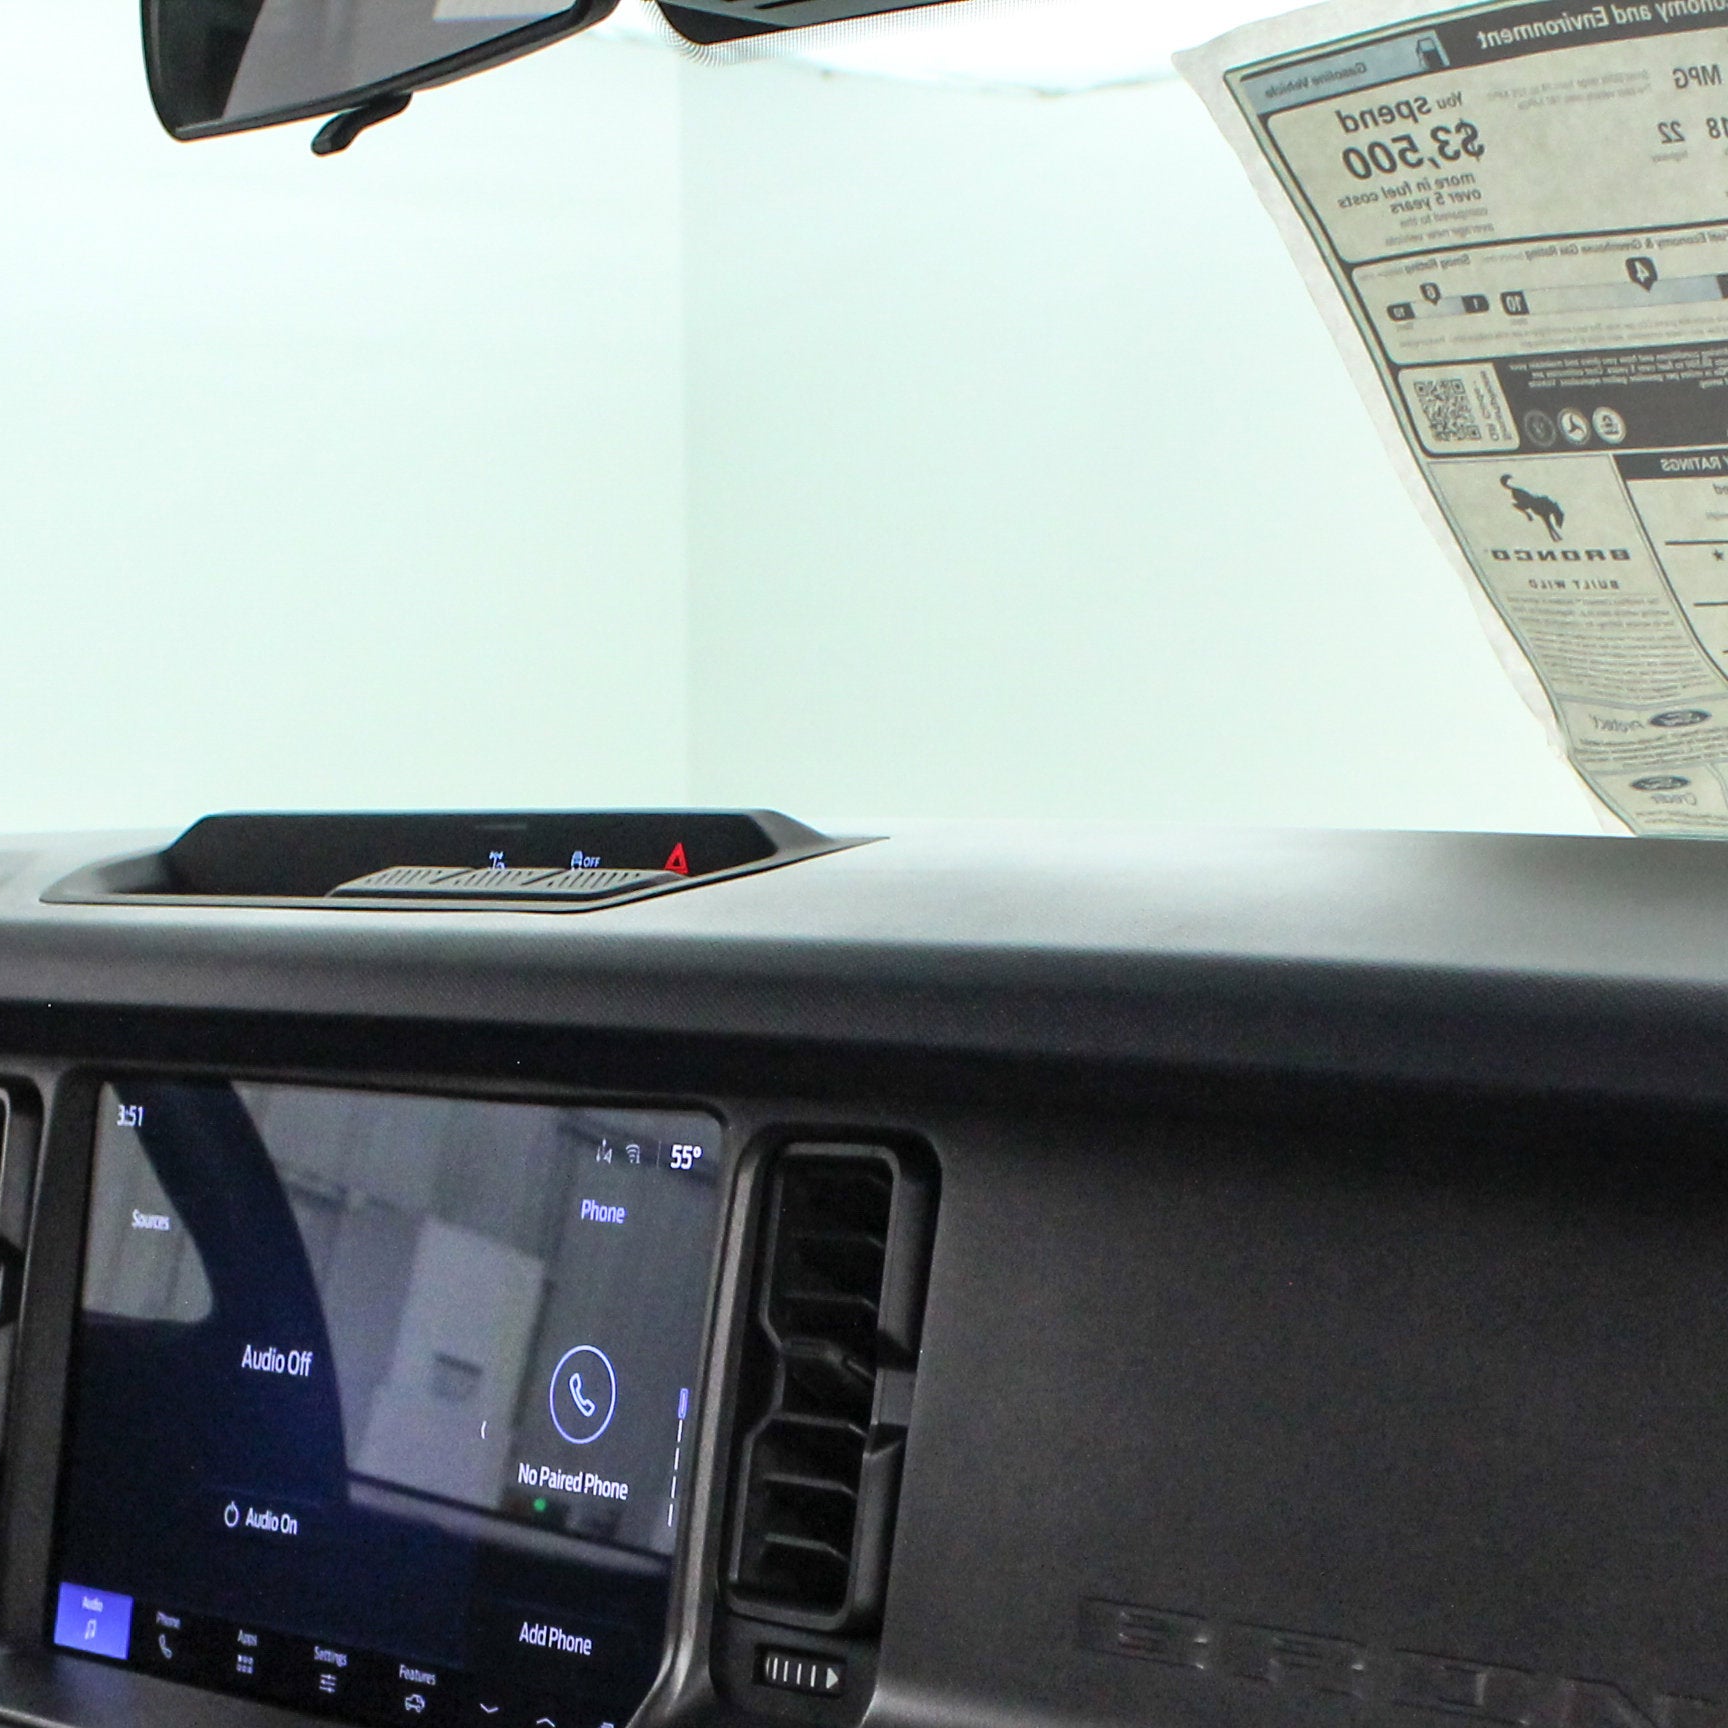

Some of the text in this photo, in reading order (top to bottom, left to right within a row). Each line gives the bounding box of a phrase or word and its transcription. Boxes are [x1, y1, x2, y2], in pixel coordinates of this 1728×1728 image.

[583, 856, 601, 868] OFF
[117, 1104, 143, 1127] 3:51
[671, 1144, 702, 1169] 55°
[581, 1199, 626, 1224] Phone
[241, 1344, 312, 1377] Audio Off
[518, 1463, 628, 1500] No Paired Phone
[245, 1507, 298, 1535] Audio On
[519, 1621, 592, 1656] Add Phone
[314, 1646, 347, 1668] Settings
[399, 1664, 436, 1686] Features
